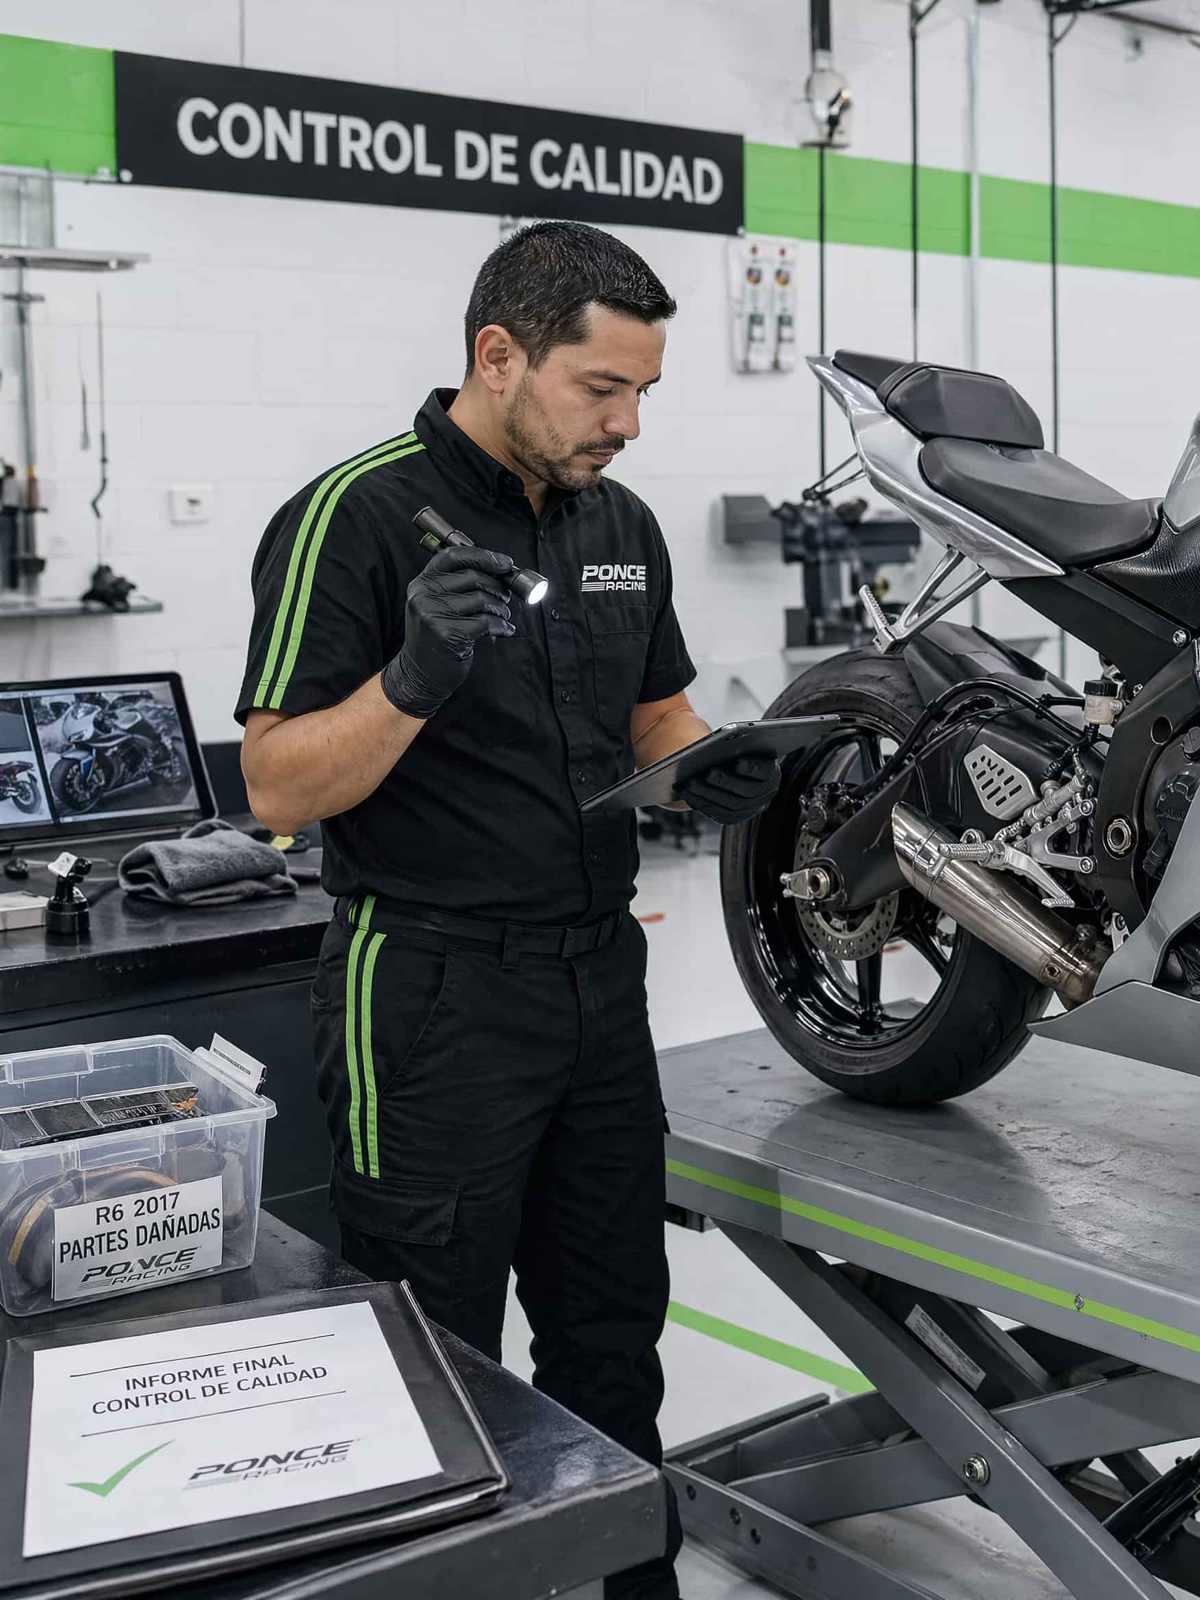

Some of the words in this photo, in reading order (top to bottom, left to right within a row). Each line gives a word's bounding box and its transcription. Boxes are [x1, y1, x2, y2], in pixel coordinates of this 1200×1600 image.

[177, 97, 443, 177] CONTROL
[454, 129, 520, 186] DE
[529, 138, 724, 205] CALIDAD
[581, 564, 647, 581] PONCE
[605, 581, 647, 591] RACING
[96, 1203, 124, 1226] R6
[133, 1191, 180, 1218] 2017
[59, 1228, 129, 1263] PARTES
[136, 1207, 221, 1247] DAÑADAS
[80, 1246, 199, 1283] PONCE
[111, 1261, 192, 1286] RACING
[92, 1388, 197, 1415] CONTROL
[201, 1381, 231, 1399] DE
[236, 1366, 328, 1392] CALIDAD
[125, 1364, 227, 1391] INFORME
[232, 1354, 295, 1375] FINAL
[188, 1439, 354, 1481] PONCE
[242, 1454, 349, 1481] RACING
